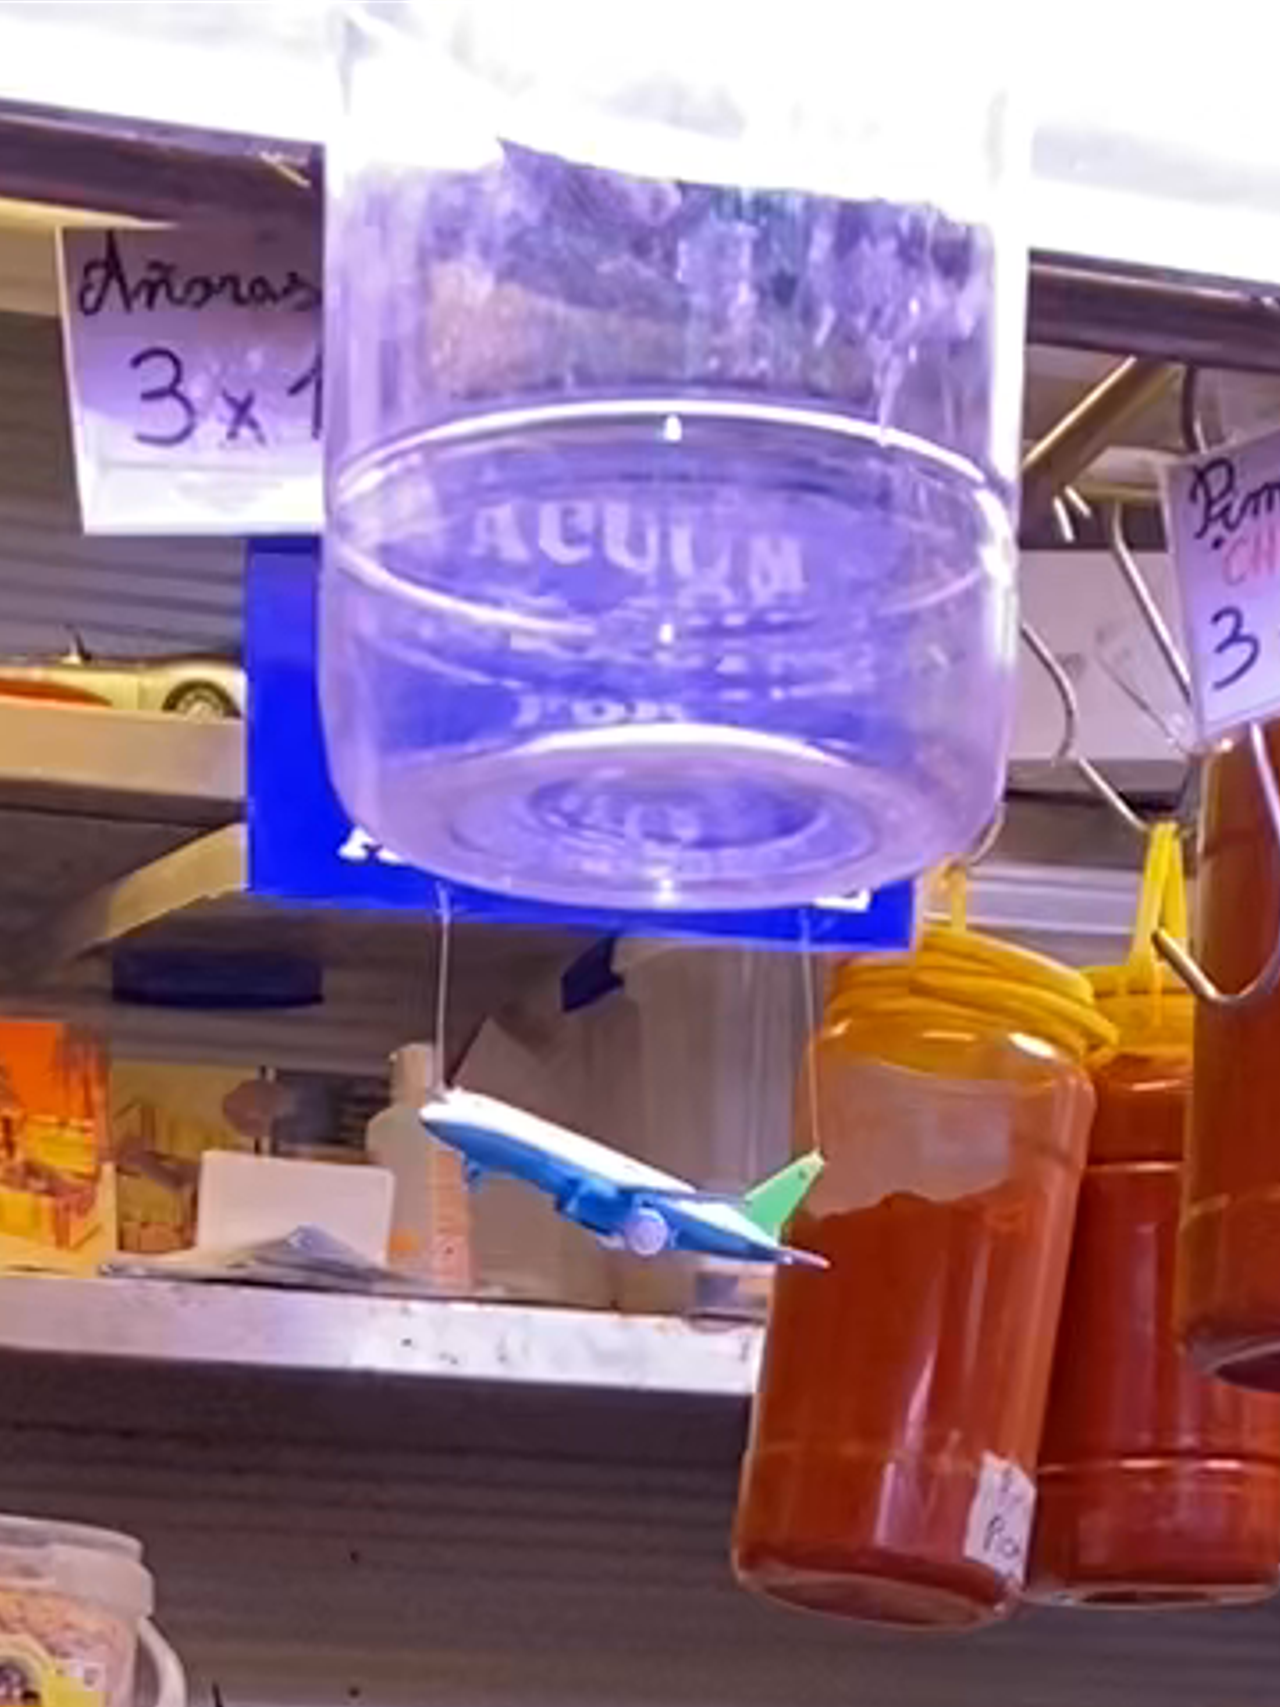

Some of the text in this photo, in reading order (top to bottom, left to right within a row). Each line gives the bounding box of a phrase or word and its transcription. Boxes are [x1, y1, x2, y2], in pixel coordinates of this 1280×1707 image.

[130, 347, 196, 446] 3
[286, 350, 321, 440] 1
[1210, 604, 1261, 690] 3
